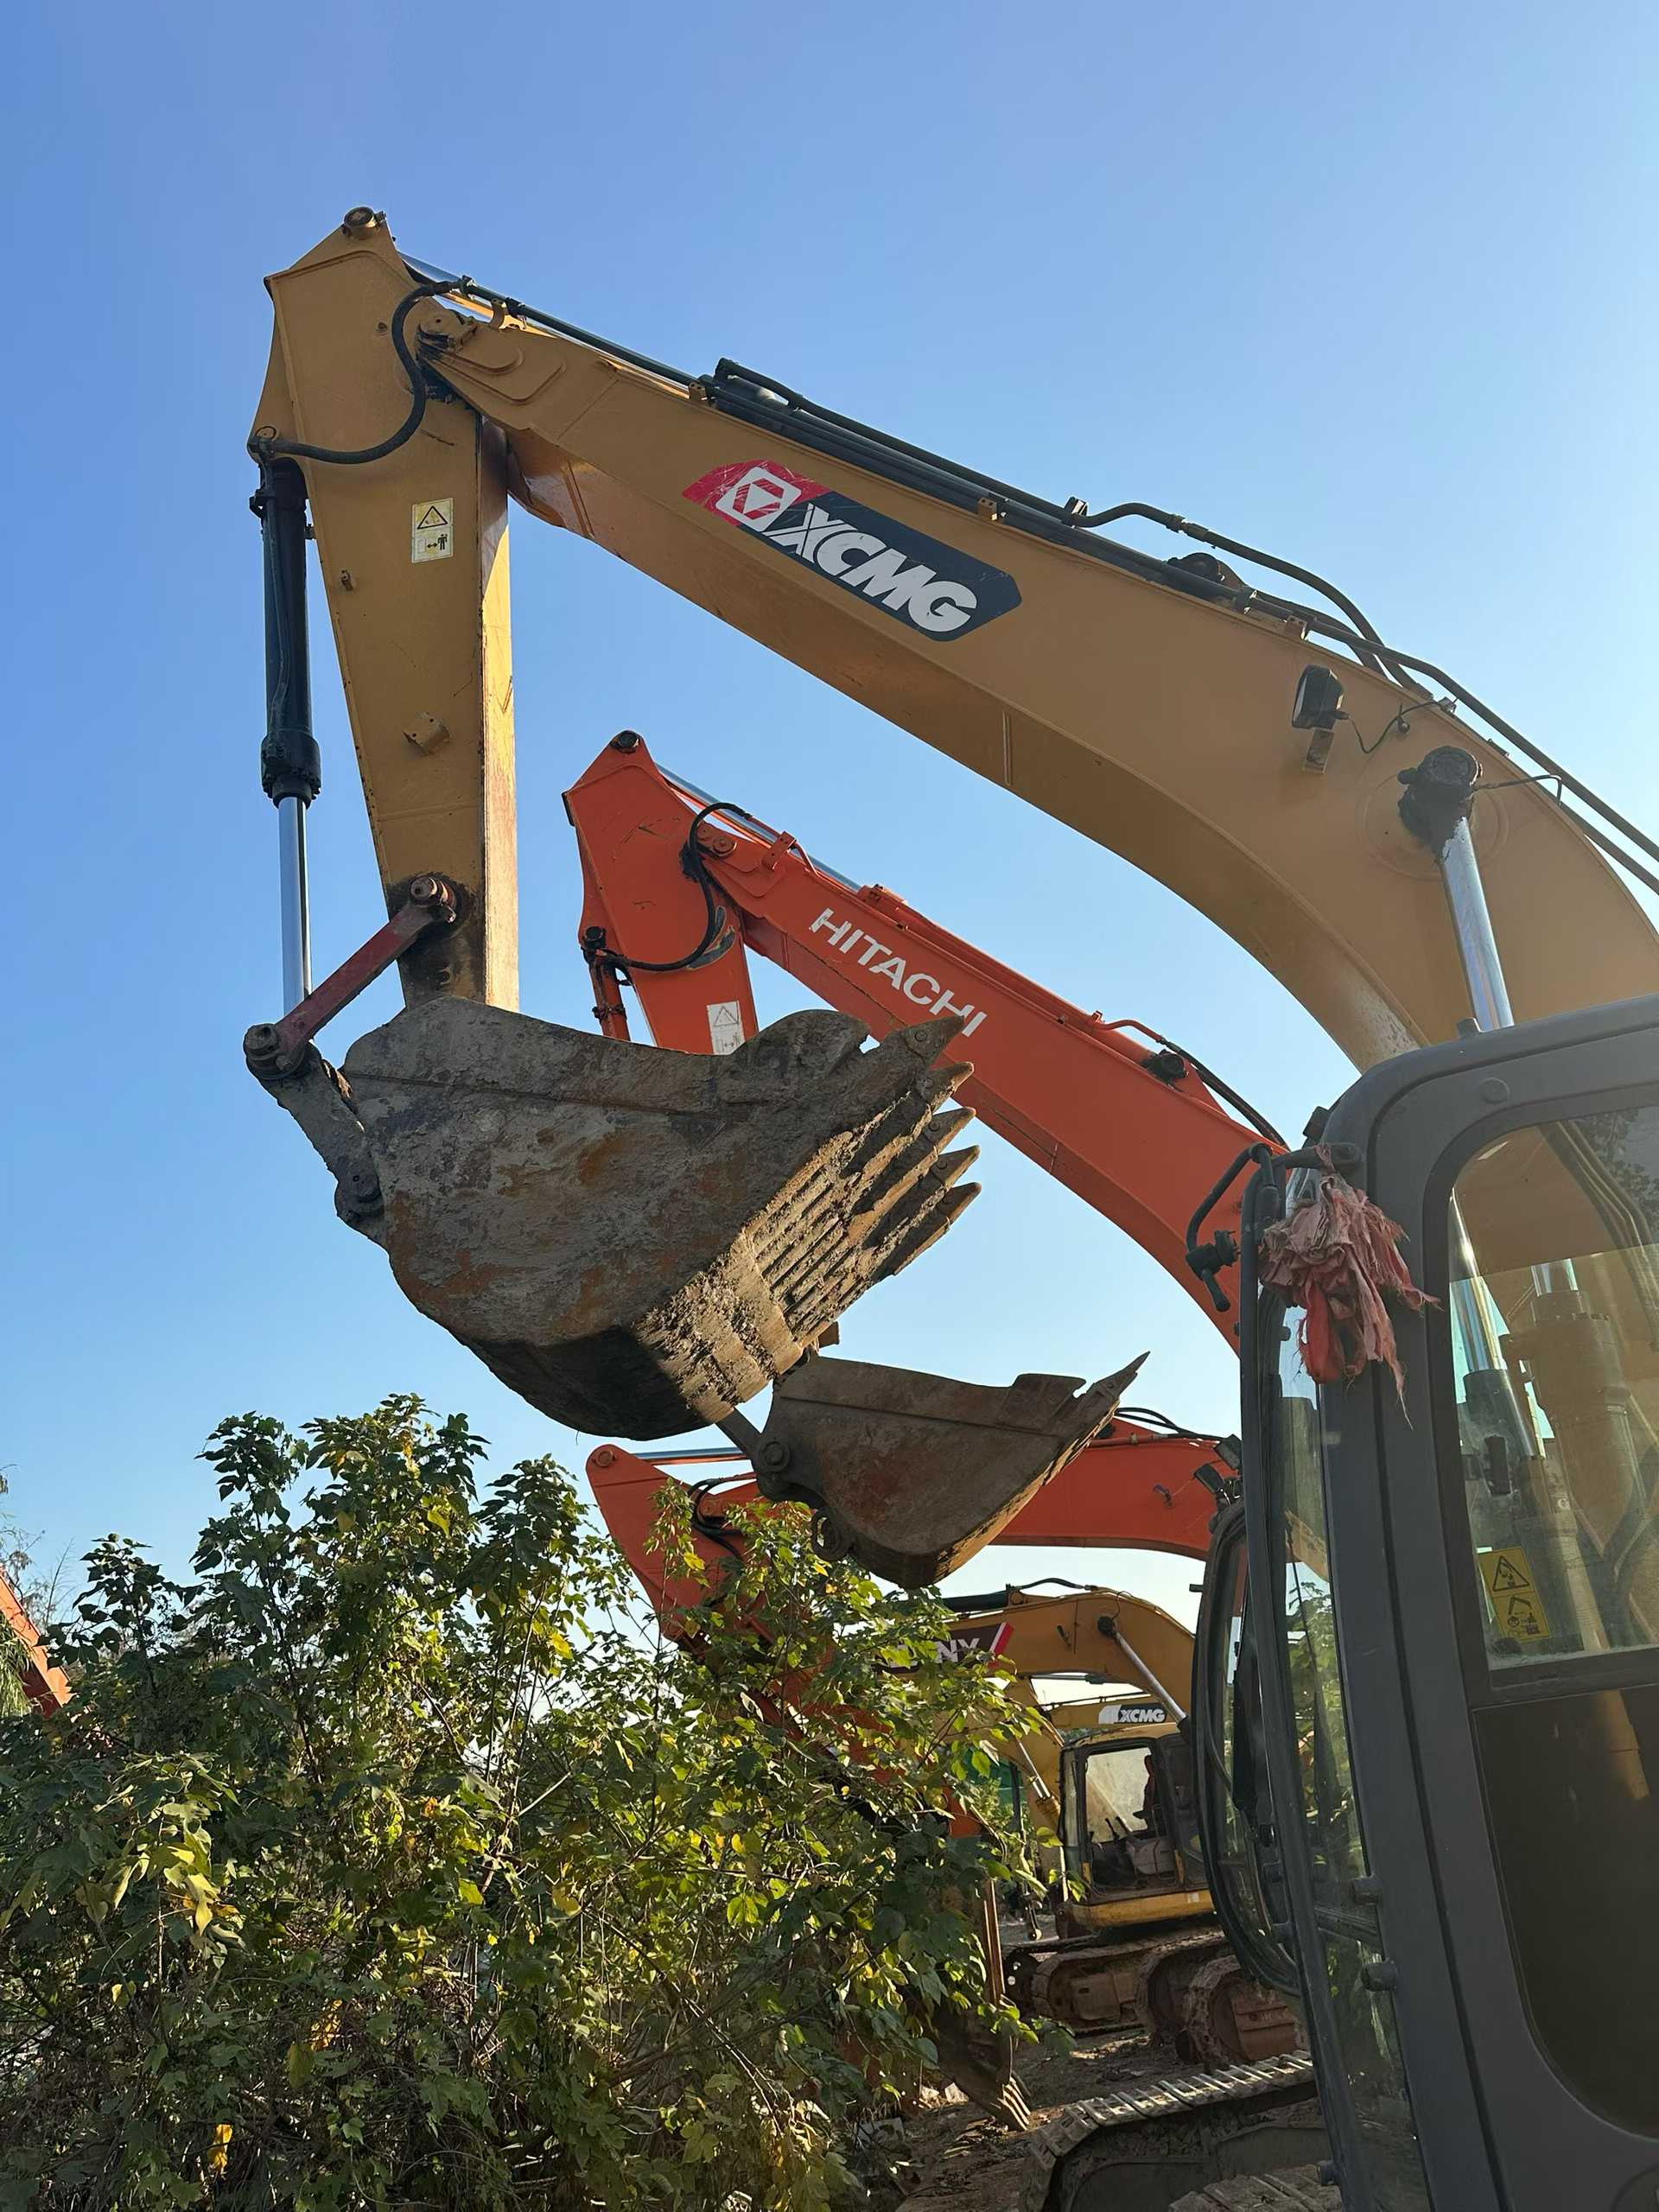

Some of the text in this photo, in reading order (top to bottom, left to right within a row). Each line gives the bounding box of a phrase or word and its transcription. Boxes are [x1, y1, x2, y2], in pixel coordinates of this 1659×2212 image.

[762, 503, 977, 632] XCMG
[809, 908, 988, 1037] HITACHI
[1119, 1709, 1166, 1723] XCMG
